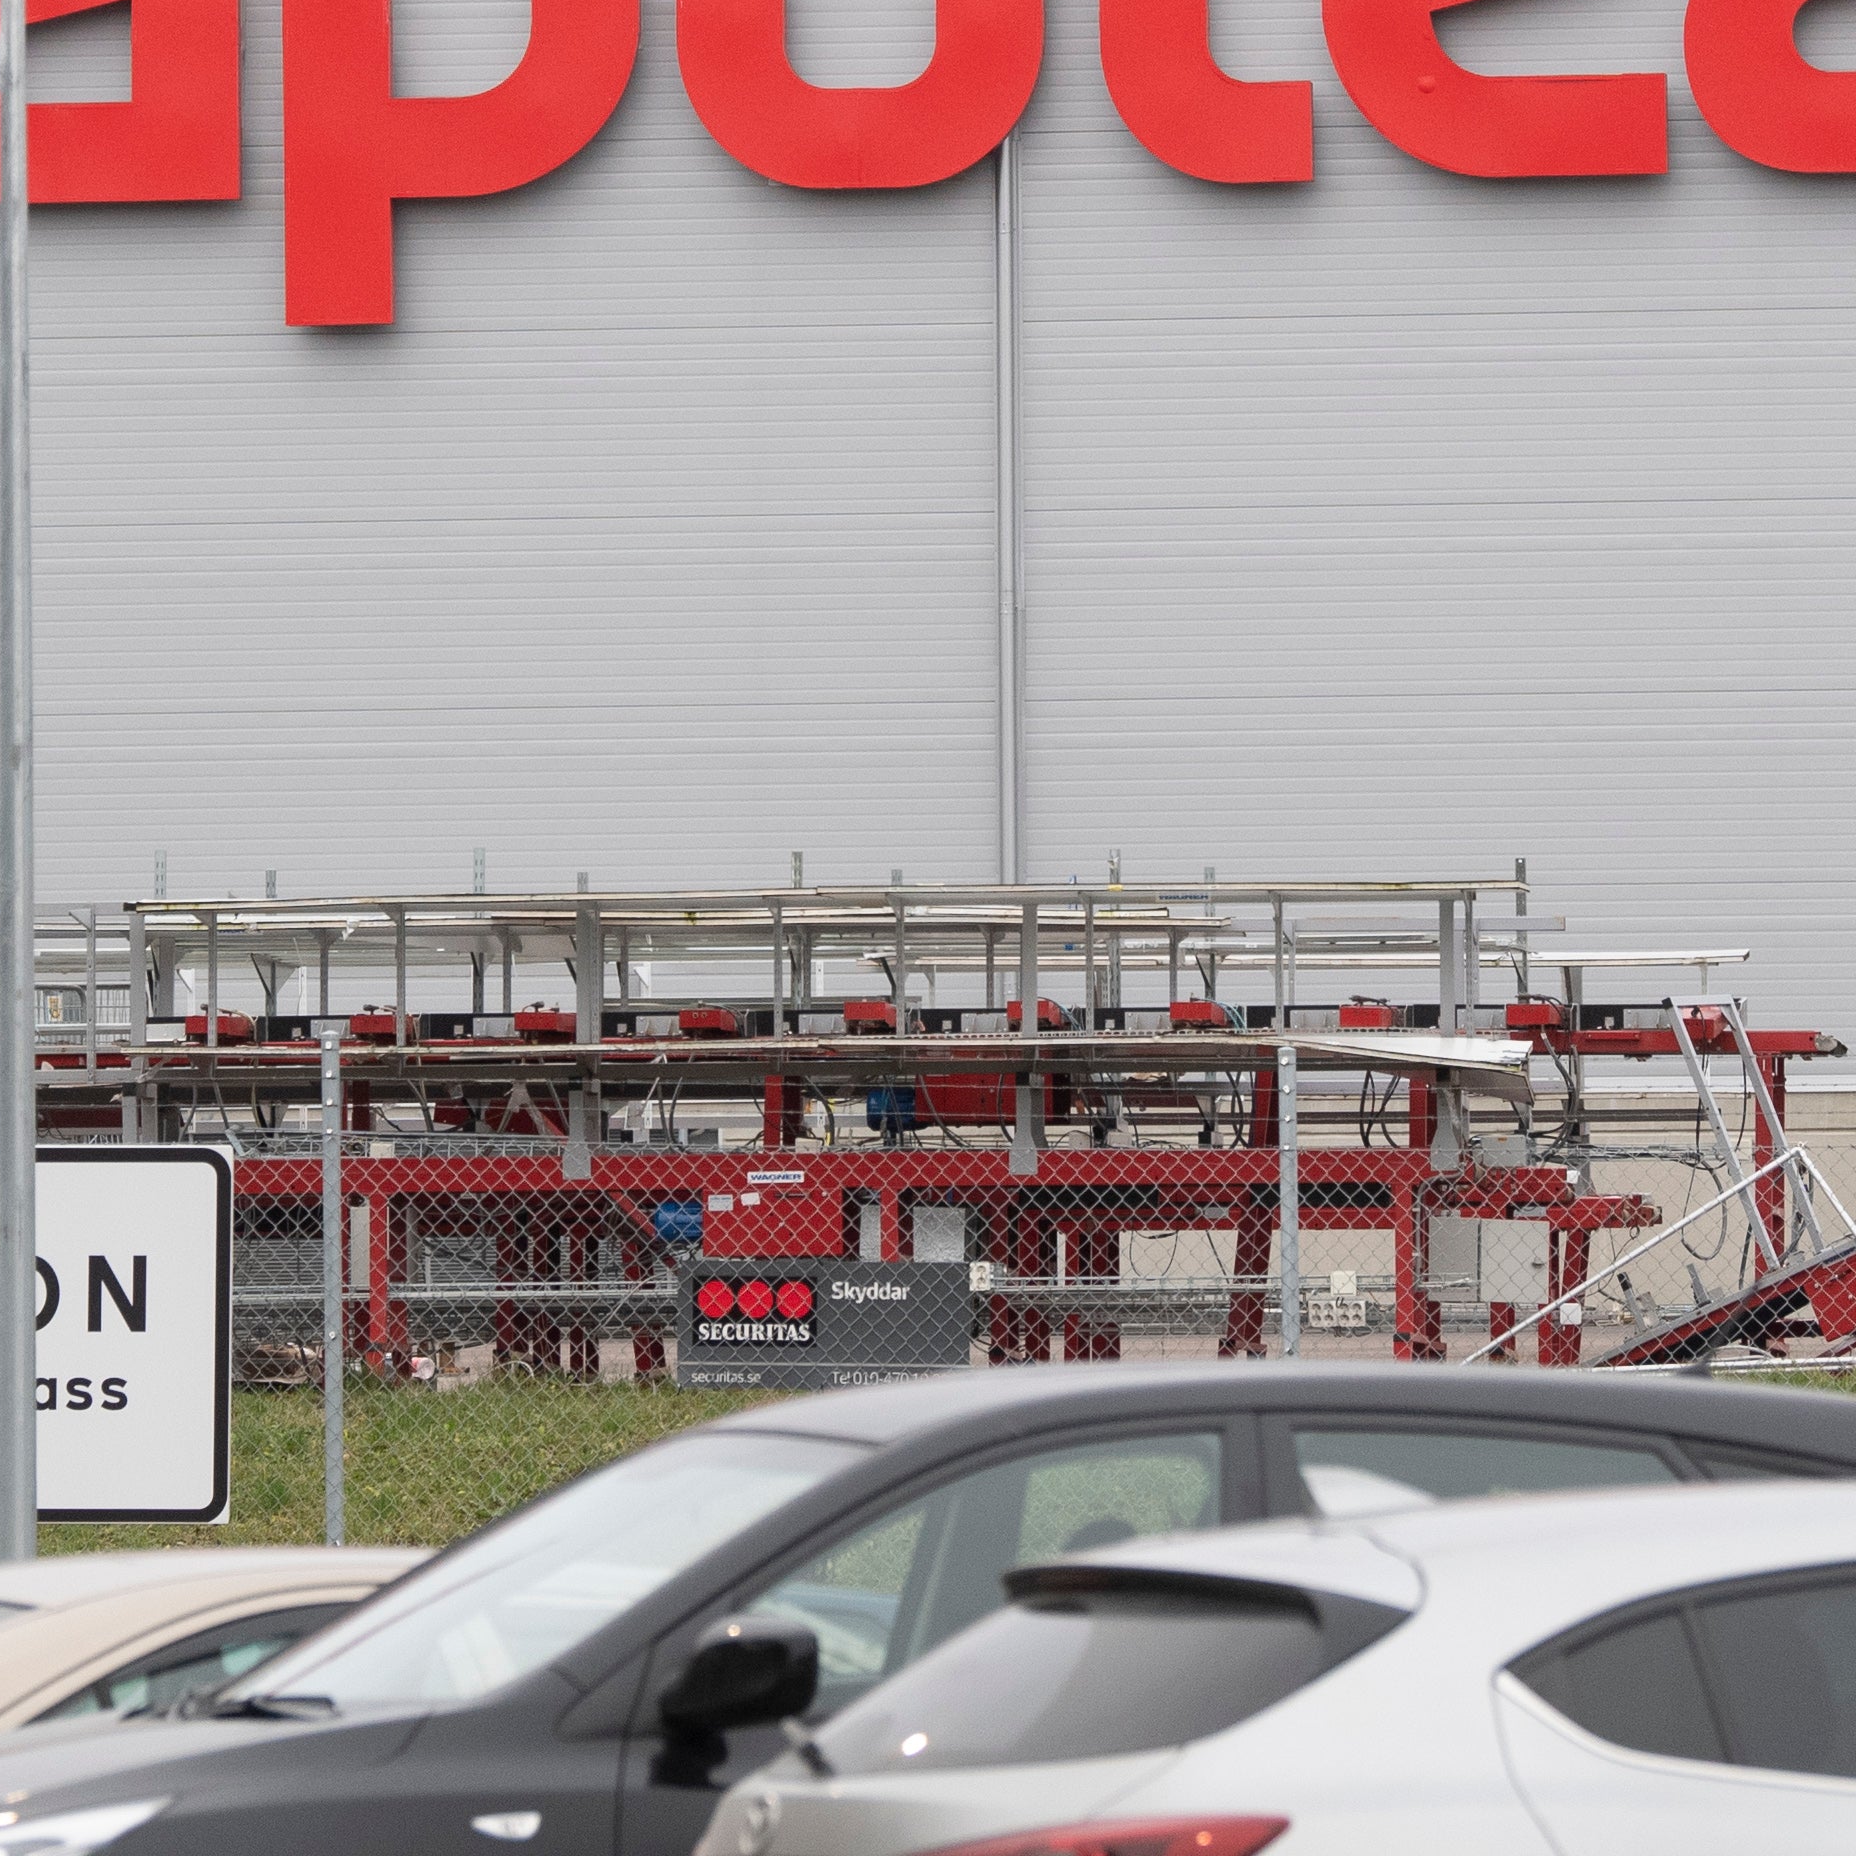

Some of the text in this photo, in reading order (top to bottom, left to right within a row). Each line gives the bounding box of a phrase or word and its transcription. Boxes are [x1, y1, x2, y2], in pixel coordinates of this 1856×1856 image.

[750, 1173, 802, 1182] WAGNER
[831, 1280, 910, 1304] Skyddar
[698, 1323, 811, 1343] SECURITAS
[691, 1370, 762, 1384] securitas.se
